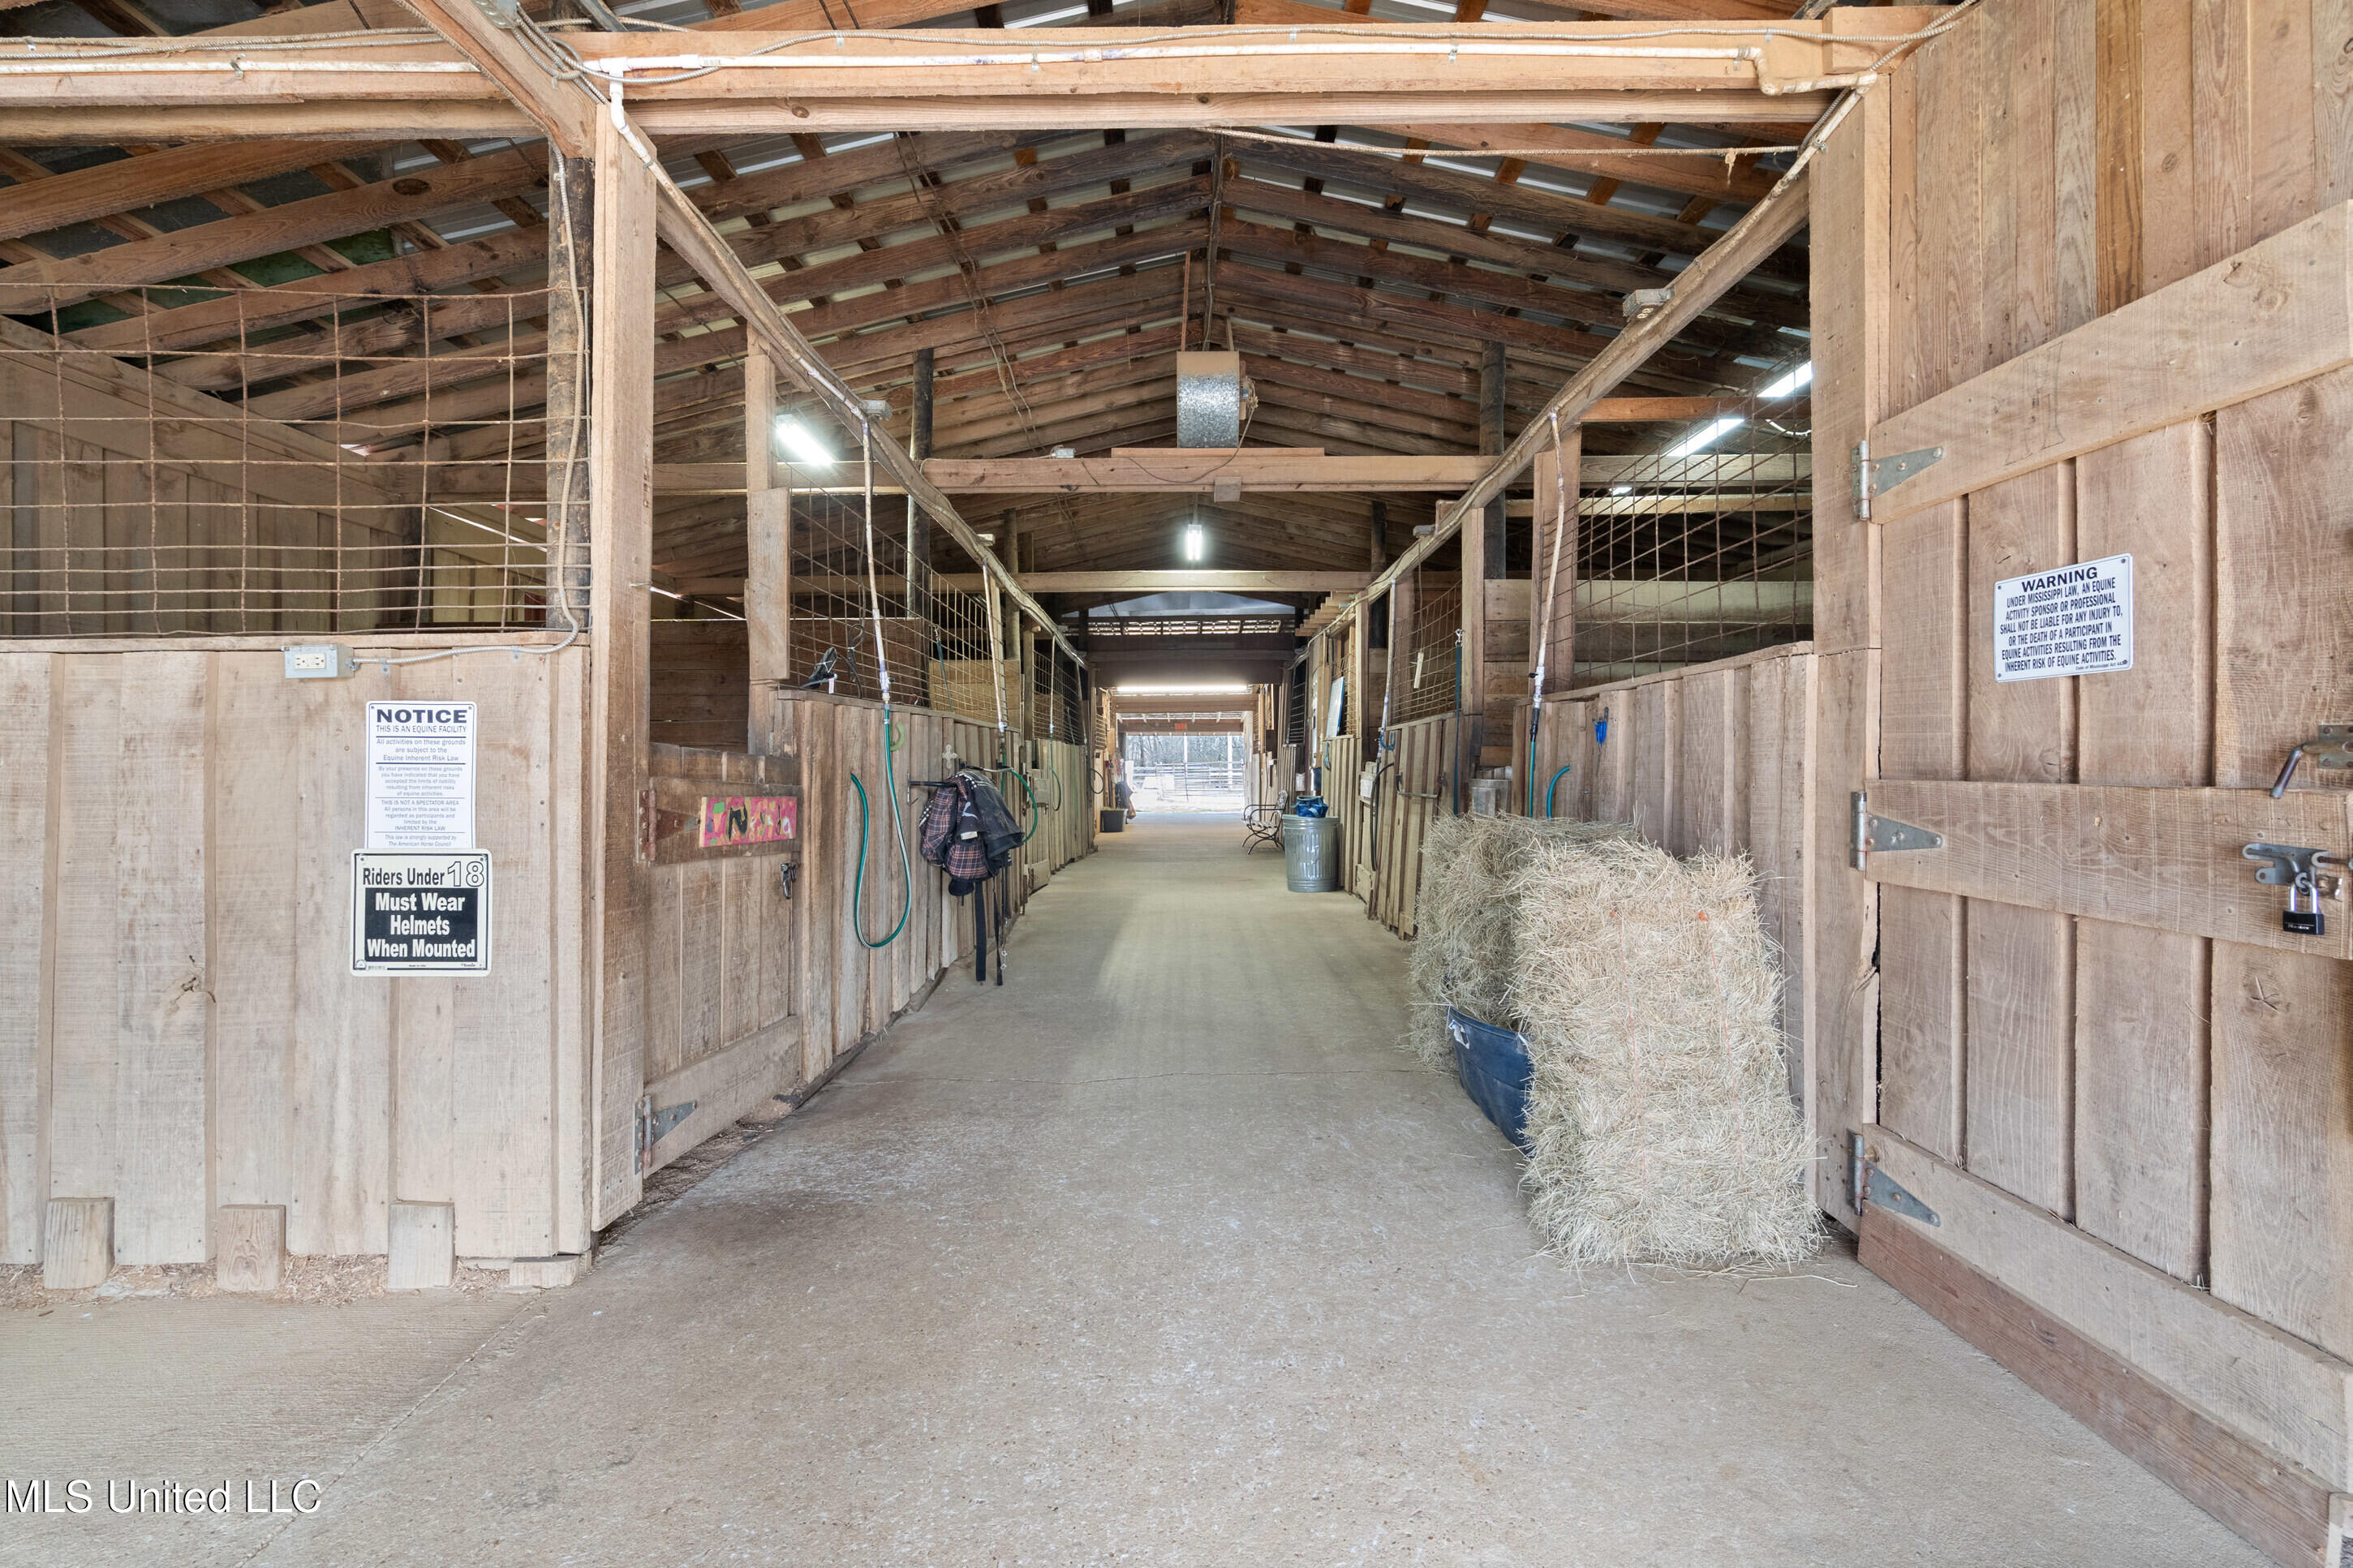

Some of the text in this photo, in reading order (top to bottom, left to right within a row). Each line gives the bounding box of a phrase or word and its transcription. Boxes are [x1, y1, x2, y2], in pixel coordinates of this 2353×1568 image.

[2022, 567, 2097, 592] WARNING
[2007, 577, 2115, 608] UNDER MISSISSIPPI LAW, AN EQUINE
[2006, 592, 2116, 621] ACTIVITY SPONSOR OR PROFESSIONAL
[2000, 605, 2122, 635] SHALL NOT BE LIABLE FOR ANY INJURY TO,
[2009, 622, 2112, 646] OR THE DEATH OF A PARTICIPANT IN
[2002, 634, 2121, 660] EQUINE ACTIVITIES RESULTING FROM THE
[2005, 650, 2116, 672] INHERENT RISK OF EQUINE ACTIVITIES.
[377, 709, 467, 723] NOTICE
[363, 861, 484, 887] Riders Under 18
[375, 893, 465, 911] Must Wear
[390, 915, 450, 935] Helmets
[367, 939, 475, 958] When Mounted
